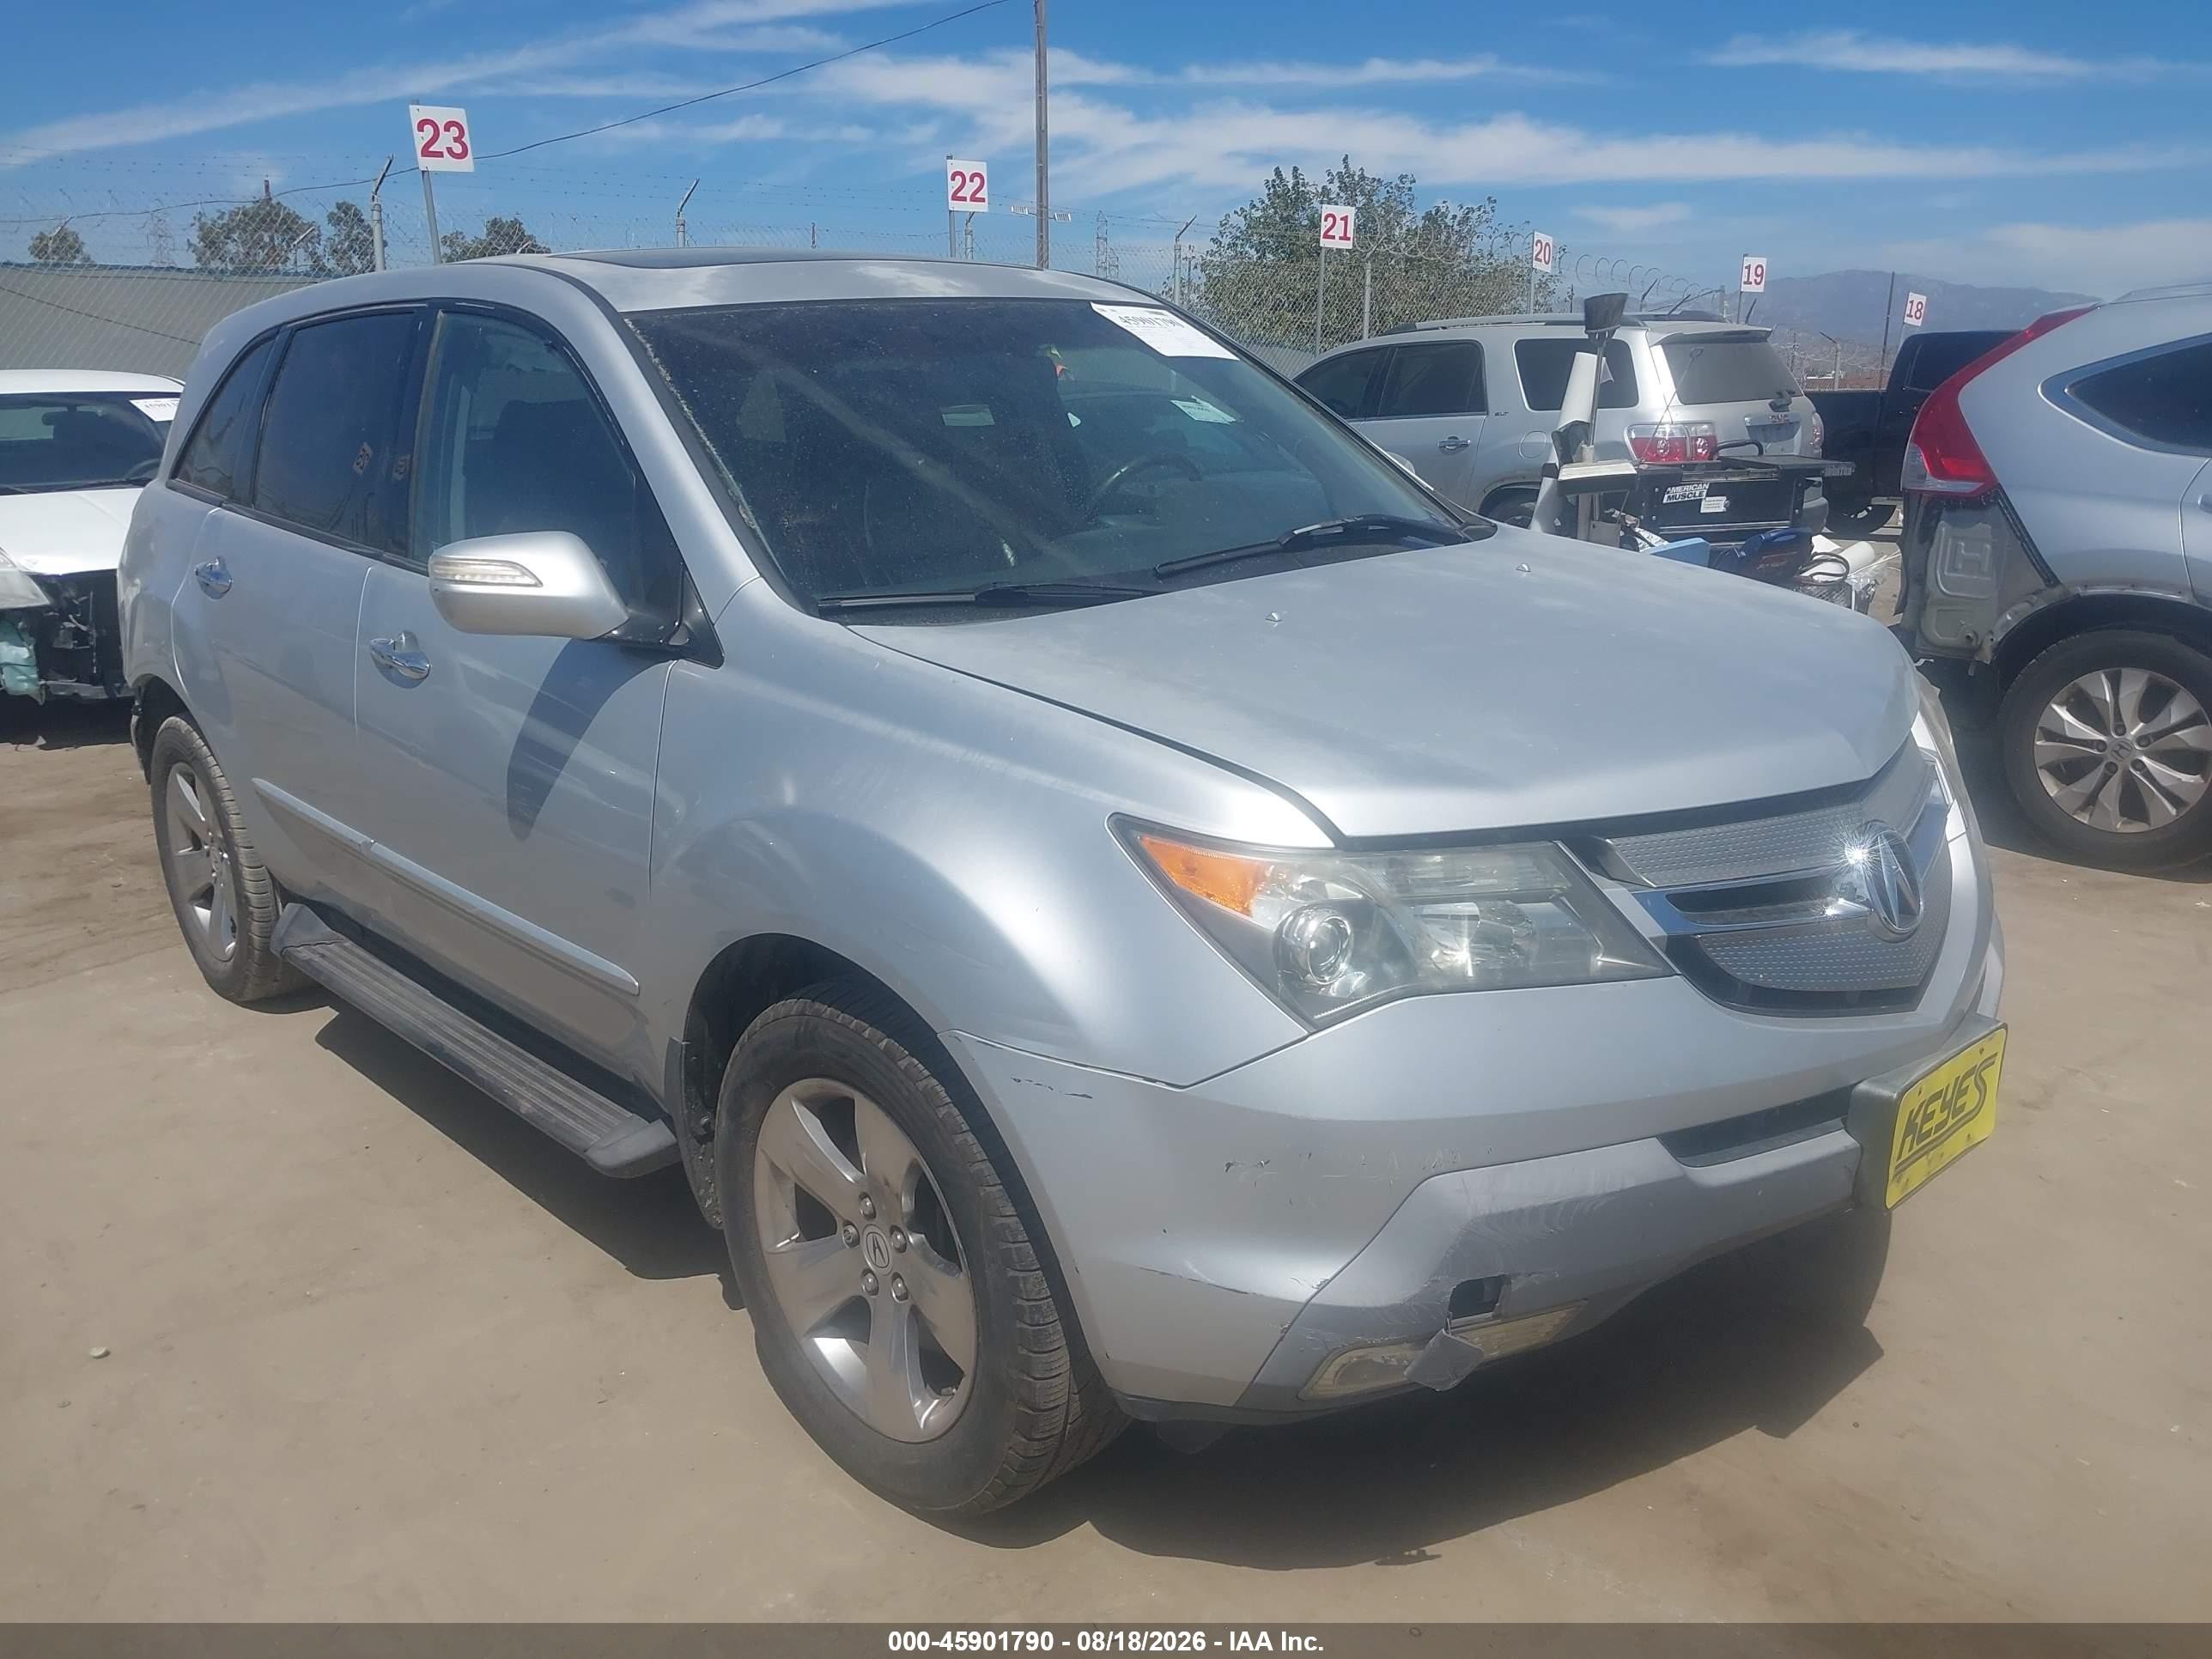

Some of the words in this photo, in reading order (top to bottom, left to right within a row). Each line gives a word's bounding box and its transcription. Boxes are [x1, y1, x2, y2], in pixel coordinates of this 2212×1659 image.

[416, 118, 469, 161] 23
[950, 169, 987, 204] 22
[1322, 211, 1352, 242] 21
[1534, 239, 1551, 265] 20
[1743, 264, 1764, 285] 19
[1906, 300, 1923, 319] 18
[1665, 482, 1711, 495] AMERICAN
[1666, 489, 1707, 502] MUSCLE
